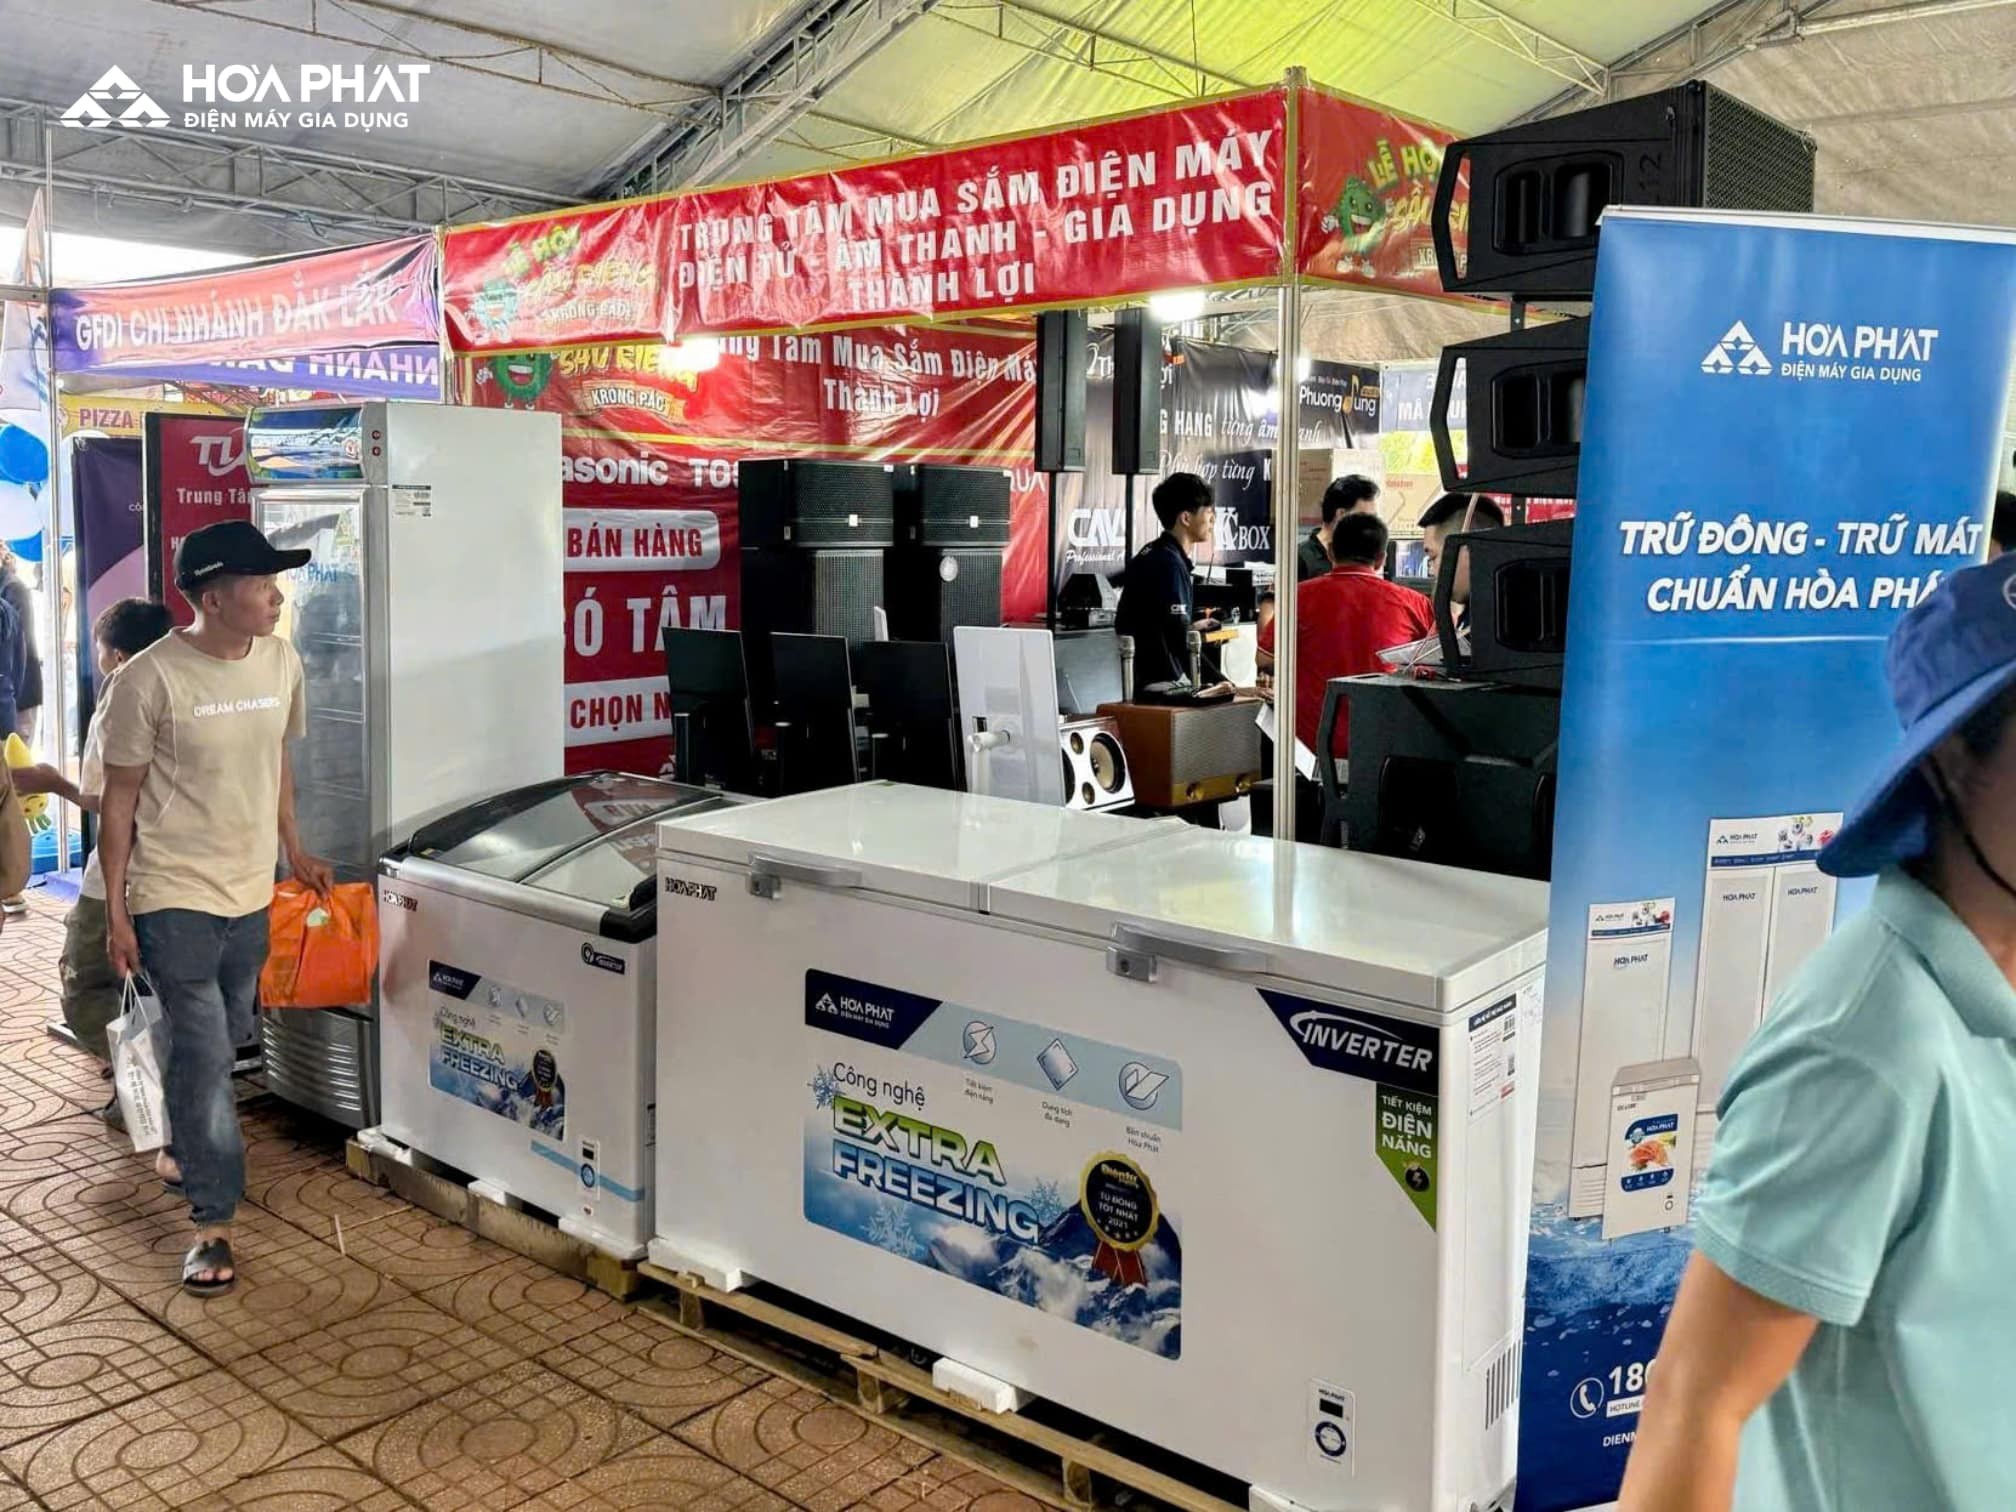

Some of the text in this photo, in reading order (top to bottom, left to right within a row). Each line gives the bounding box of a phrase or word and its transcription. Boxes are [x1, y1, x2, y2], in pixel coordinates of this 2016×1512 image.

[681, 127, 1273, 250] TRUNG TÂM MUA SẮM ĐIỆN MÁY
[679, 253, 748, 290] ĐIỆN
[759, 241, 797, 281] TỬ
[836, 238, 882, 273] ÂM
[899, 220, 1017, 264] THANH
[1064, 204, 1135, 244] GIA
[1153, 181, 1273, 234] DỤNG
[849, 260, 1035, 310] THÀNH LỢI
[76, 316, 123, 350] GFDI
[1854, 325, 1939, 361] PHÁT
[833, 336, 892, 370] Mua
[894, 338, 944, 376] Sắm
[951, 349, 998, 387] Điện
[1005, 353, 1036, 383] Má
[1781, 361, 1921, 385] ĐIỆN MÁY GIA DỤNG
[79, 407, 133, 429] PIZZA
[823, 379, 940, 423] Thành Lợi
[562, 452, 669, 486] asonic
[177, 487, 224, 506] Trung
[567, 522, 703, 557] BÁN HÀNG
[1620, 511, 1695, 555] TRỮ
[1698, 513, 1808, 556] ĐÔNG
[1837, 513, 1908, 556] TRỮ
[1913, 516, 1984, 556] MÁT
[1647, 564, 1944, 612] CHUẨN HÒA PHÁ
[563, 585, 726, 657] Ó TÂM
[193, 702, 235, 718] DREAM
[571, 693, 643, 731] CHỌN
[440, 1023, 505, 1065] EXTRA
[1304, 1022, 1433, 1072] INVERTER
[440, 1045, 519, 1092] FREEZING
[833, 1062, 925, 1112] Công nghệ
[1381, 1095, 1432, 1117] TIẾT KIỆM
[1381, 1109, 1432, 1141] ĐIỆN
[834, 1095, 1007, 1187] EXTRA
[1382, 1133, 1432, 1158] NĂNG
[833, 1138, 1040, 1244] FREEZING
[1610, 1400, 1640, 1413] HOTLINE
